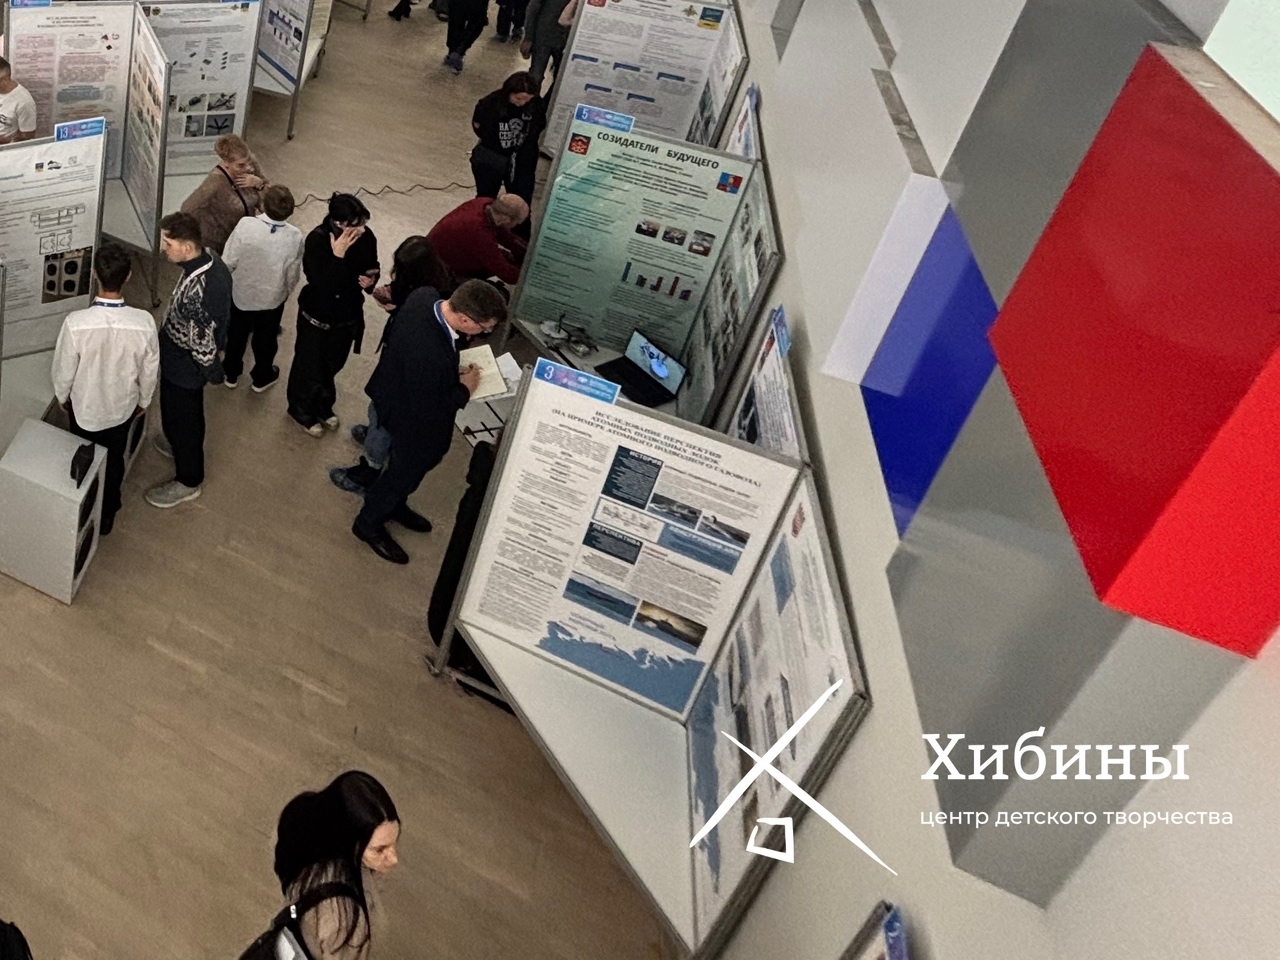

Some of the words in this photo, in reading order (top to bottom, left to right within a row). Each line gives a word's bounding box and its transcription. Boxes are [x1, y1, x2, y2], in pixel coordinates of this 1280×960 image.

[581, 108, 588, 119] 5
[59, 127, 68, 139] 13
[597, 131, 659, 154] СОЗИДАТЕЛИ
[666, 150, 719, 169] БУДУЩЕГО
[544, 365, 554, 380] 3
[568, 414, 605, 433] ПРИМЕРЕ
[607, 427, 654, 450] АТОМНОГО
[591, 416, 633, 435] АТОМНЫХ
[595, 410, 662, 439] ИССЛЕДОВАНИЕ
[629, 451, 663, 466] ИСТОРИЯ
